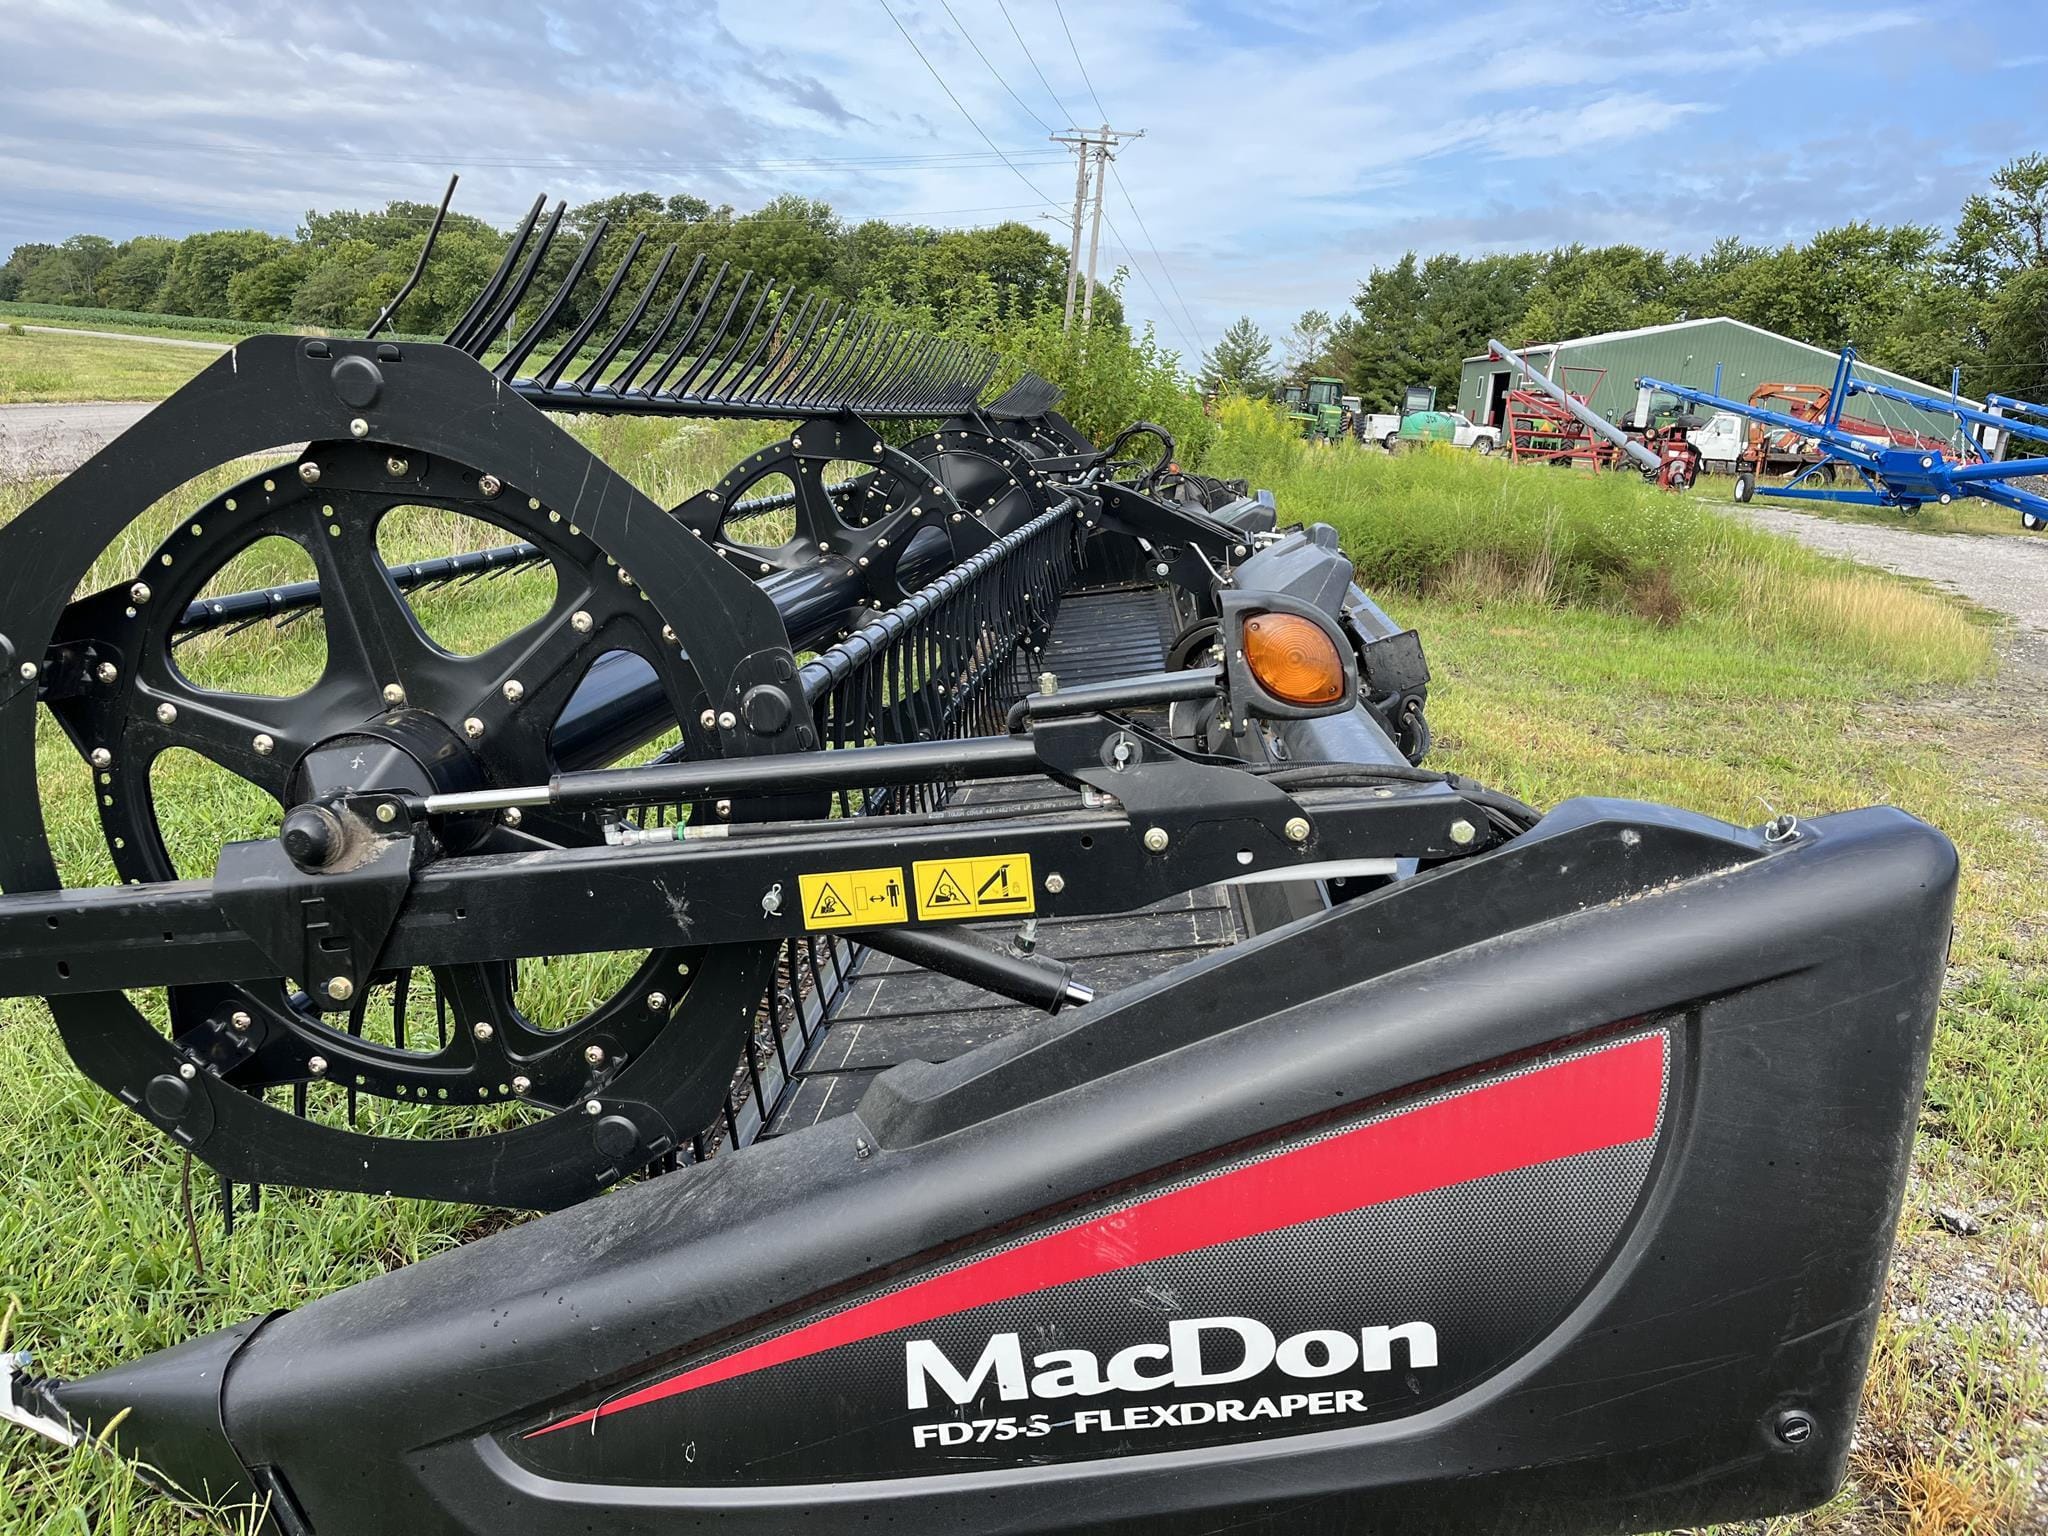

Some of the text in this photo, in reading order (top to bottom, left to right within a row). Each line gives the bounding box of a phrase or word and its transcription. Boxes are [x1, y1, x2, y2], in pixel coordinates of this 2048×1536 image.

[906, 1316, 1438, 1409] MacDon
[913, 1389, 1368, 1448] FD75-S FLEXDRAPER
